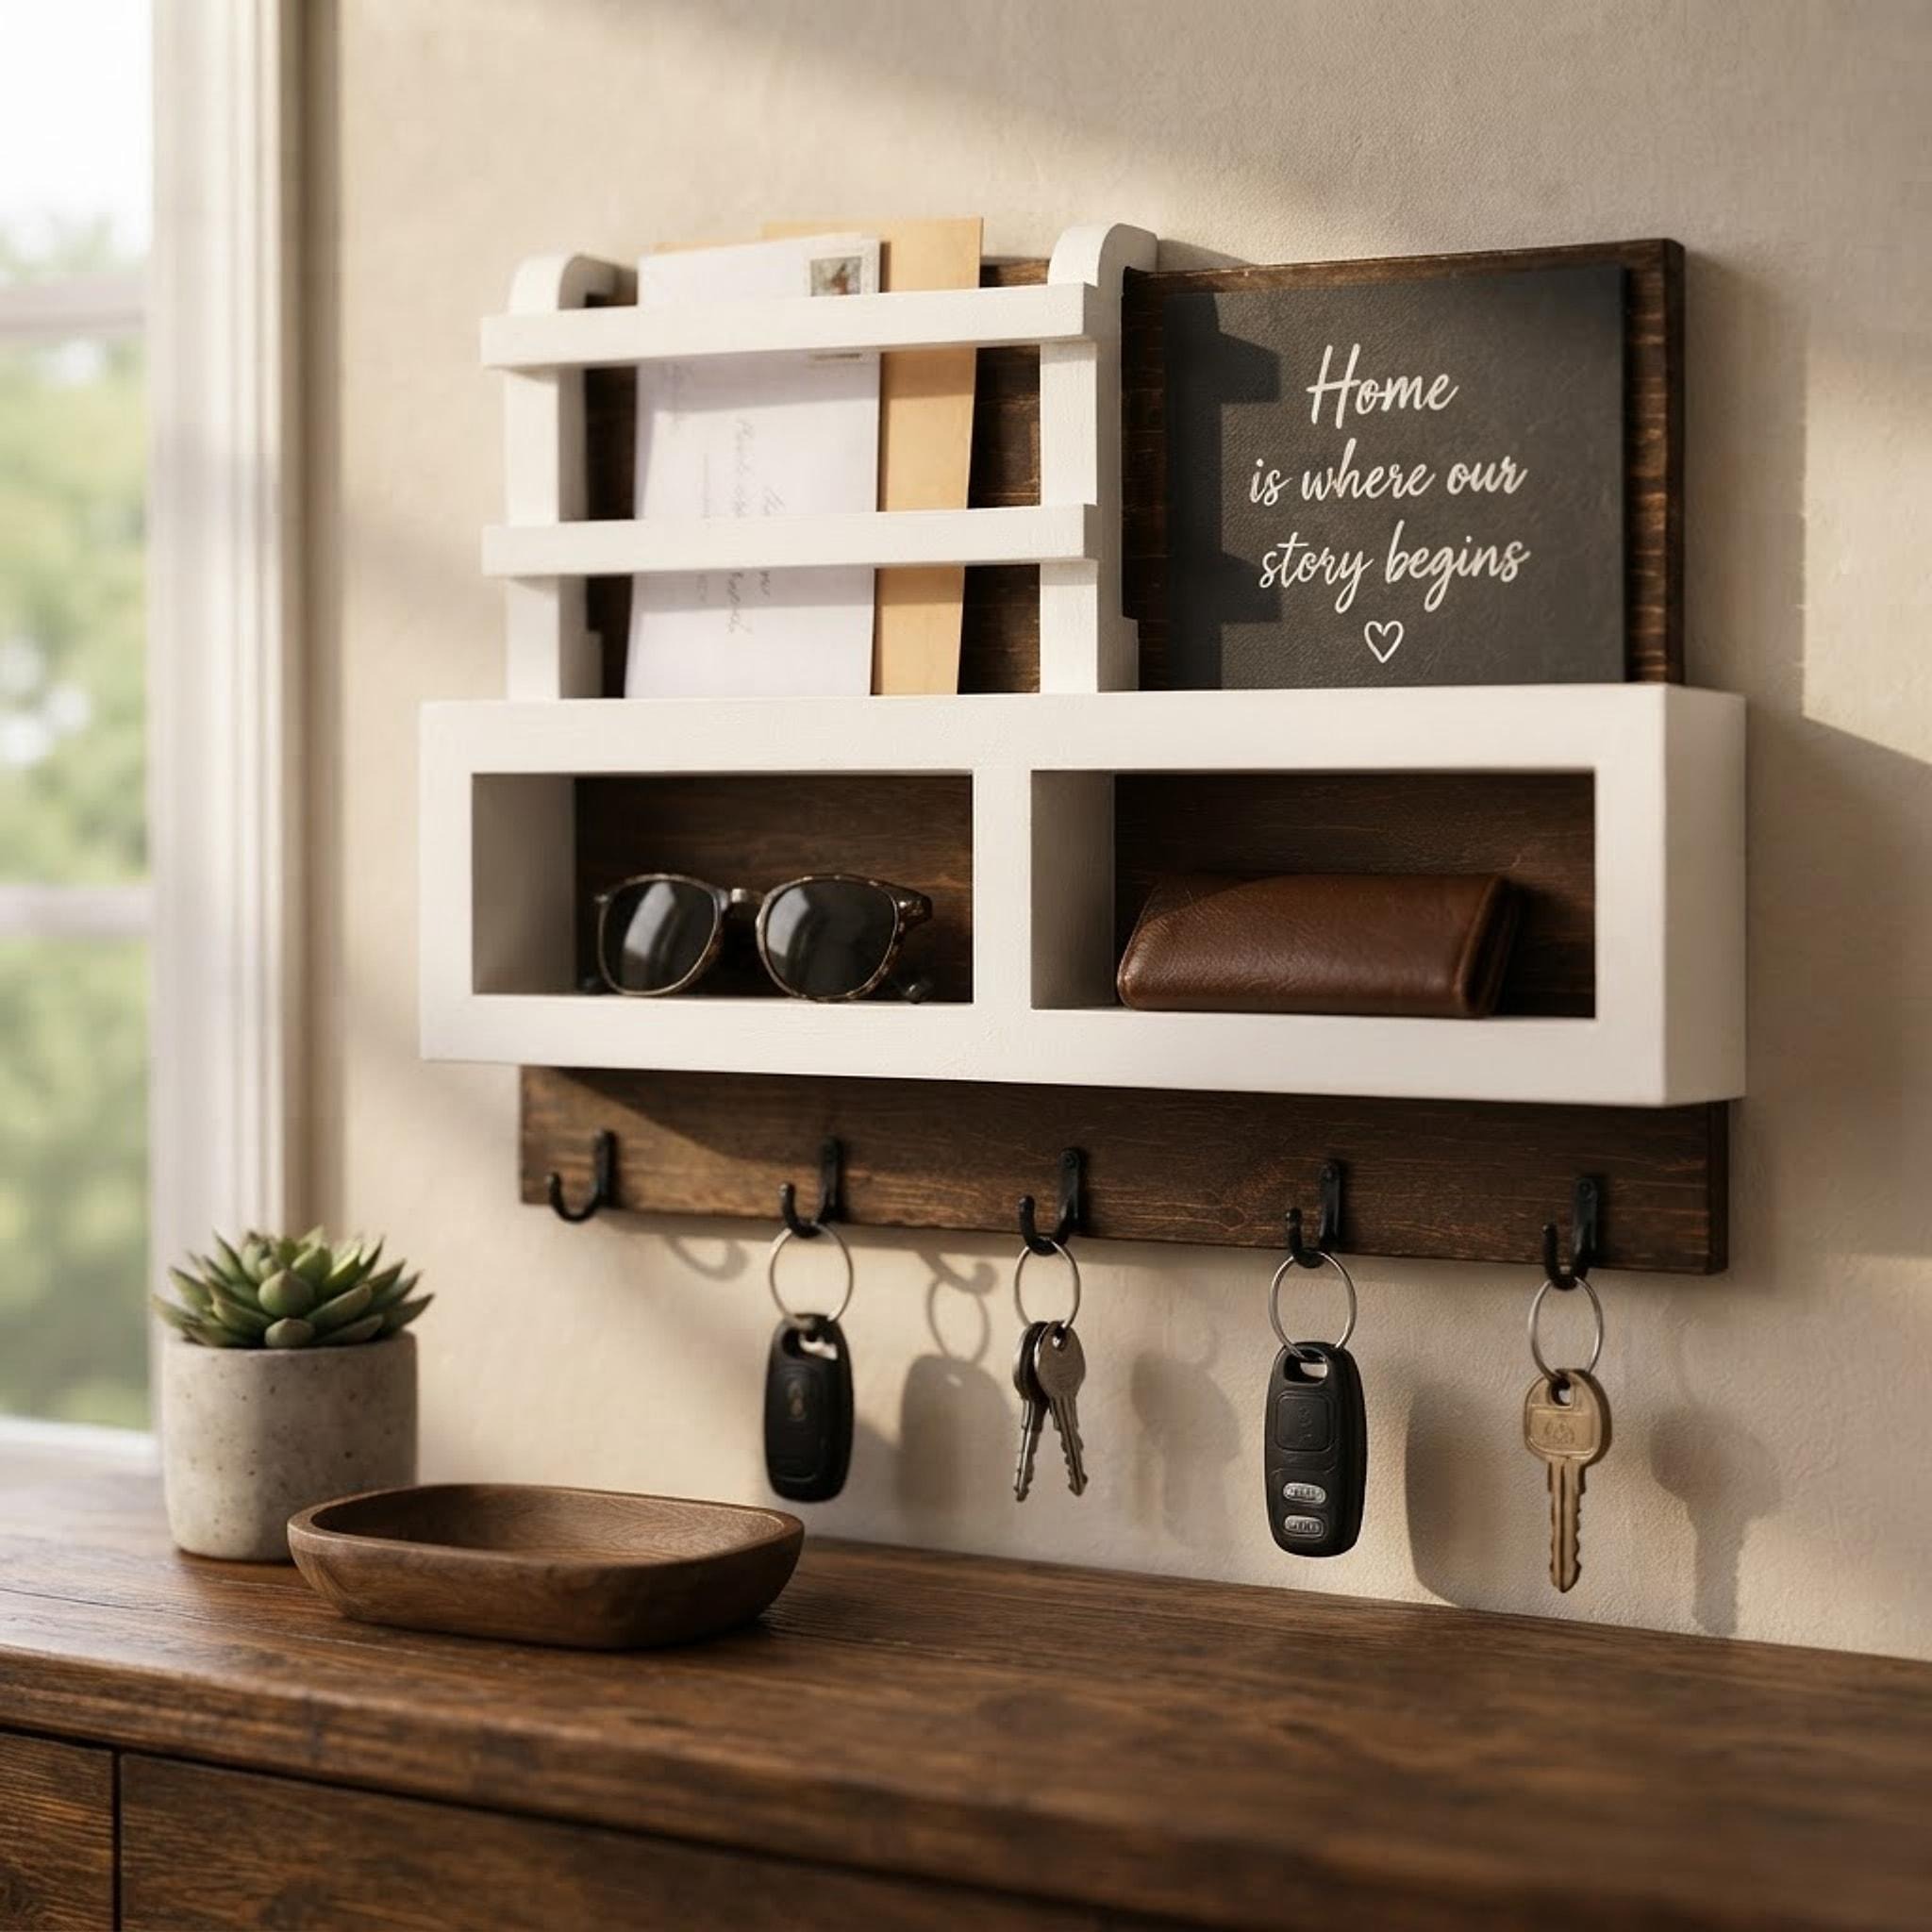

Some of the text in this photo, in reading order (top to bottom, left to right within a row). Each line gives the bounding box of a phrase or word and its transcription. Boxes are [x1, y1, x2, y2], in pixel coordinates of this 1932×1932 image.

[1306, 343, 1458, 429] Home
[1250, 438, 1528, 506] is where our
[1259, 520, 1530, 613] story begins
